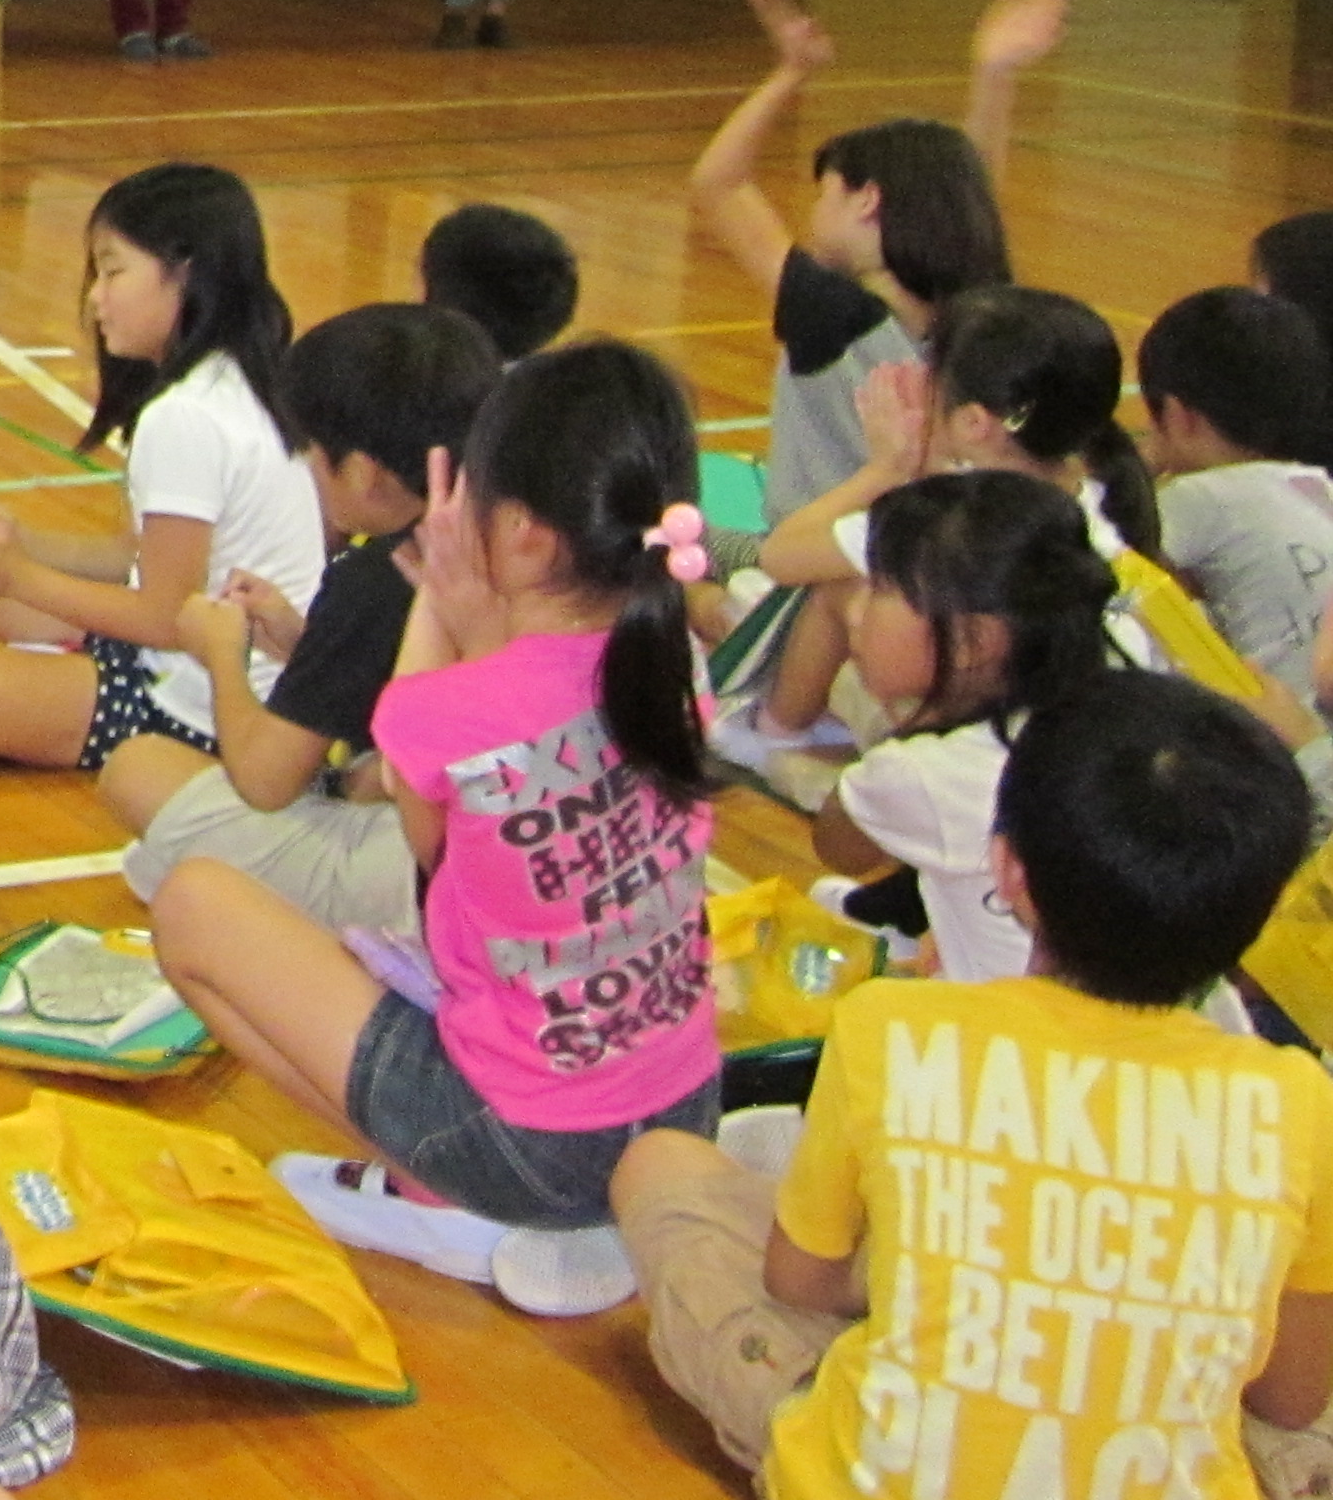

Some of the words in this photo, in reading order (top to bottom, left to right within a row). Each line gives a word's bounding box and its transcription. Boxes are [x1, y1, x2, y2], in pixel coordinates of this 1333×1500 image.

[883, 1019, 1283, 1202] MAKING
[887, 1149, 1010, 1271] THE
[1029, 1179, 1276, 1312] OCEAN
[942, 1263, 1255, 1426] BETTER
